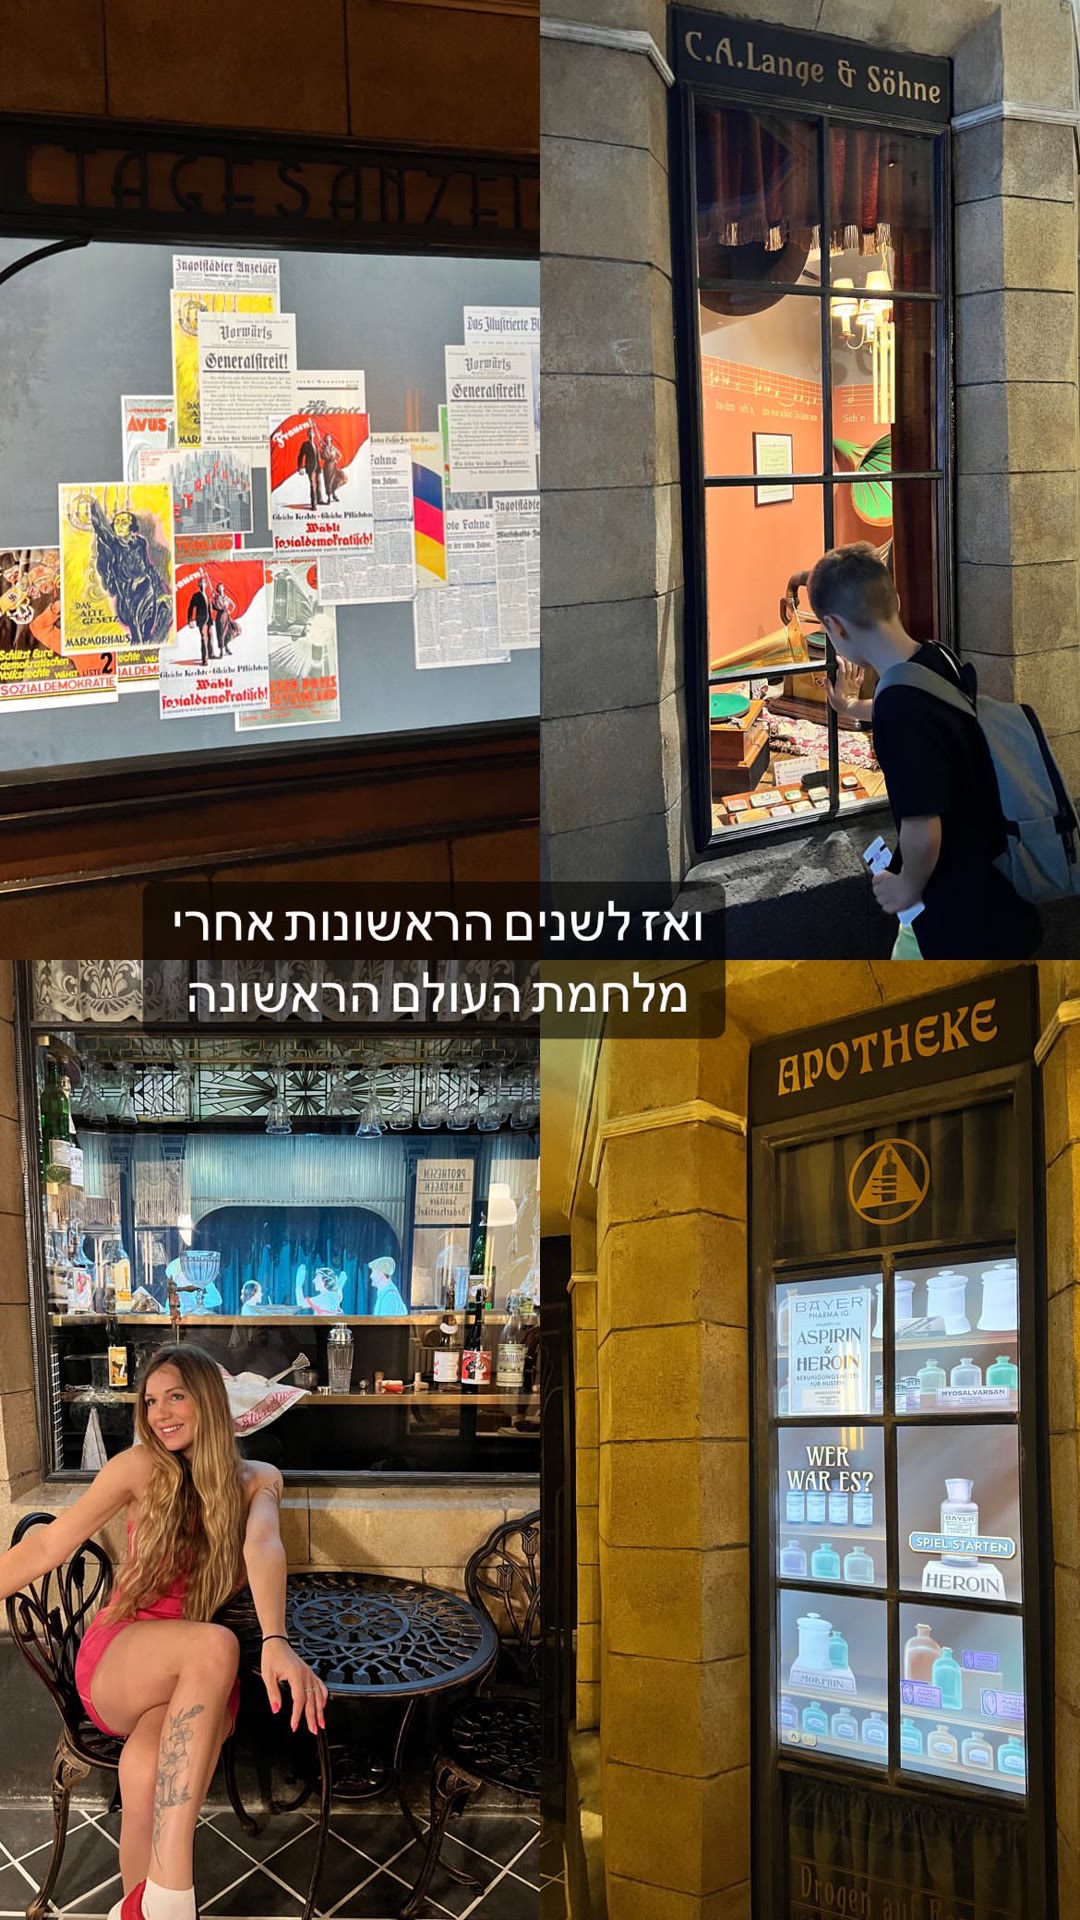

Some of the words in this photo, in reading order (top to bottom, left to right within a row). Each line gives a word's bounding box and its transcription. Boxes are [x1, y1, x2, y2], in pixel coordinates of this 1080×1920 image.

[685, 31, 825, 86] C.A.Lange
[837, 59, 857, 88] &
[867, 65, 941, 104] Söhne
[62, 146, 540, 230] TAGESANZEI
[467, 316, 483, 330] Das
[219, 325, 273, 340] Vorwärts
[205, 352, 288, 370] Generalstreik!
[464, 357, 511, 372] Vorwärts
[452, 384, 525, 400] Generalstreik!
[127, 415, 167, 432] AVUS
[272, 417, 313, 448] Frauen!
[306, 522, 340, 533] Wählt
[447, 522, 460, 530] ote
[462, 519, 490, 530] Fahne
[175, 567, 205, 592] rauen!
[75, 602, 92, 611] DAS
[79, 608, 105, 618] ALTE
[82, 616, 119, 626] GESETZ
[65, 634, 131, 648] MARMORHAUS
[100, 652, 113, 674] 2
[82, 669, 102, 677] LISTE
[1, 677, 115, 696] SOZIALDEMOKRATIE
[196, 679, 233, 690] Wählt
[777, 996, 998, 1096] APOTHEKE
[795, 1296, 864, 1313] BAYER
[808, 1311, 839, 1320] PHARMA
[797, 1327, 862, 1345] ASPIRIN
[824, 1345, 833, 1355] &
[797, 1355, 860, 1371] HEROIN
[941, 1389, 1005, 1397] MYOSALVARSAN
[806, 1446, 850, 1467] WER
[787, 1470, 831, 1492] WAR
[839, 1471, 874, 1493] ES?
[916, 1536, 949, 1550] SPIEL
[951, 1538, 1009, 1553] STARTEN
[926, 1573, 1001, 1594] HEROIN
[800, 1675, 844, 1688] MORPHIN
[800, 1864, 872, 1915] Drogen
